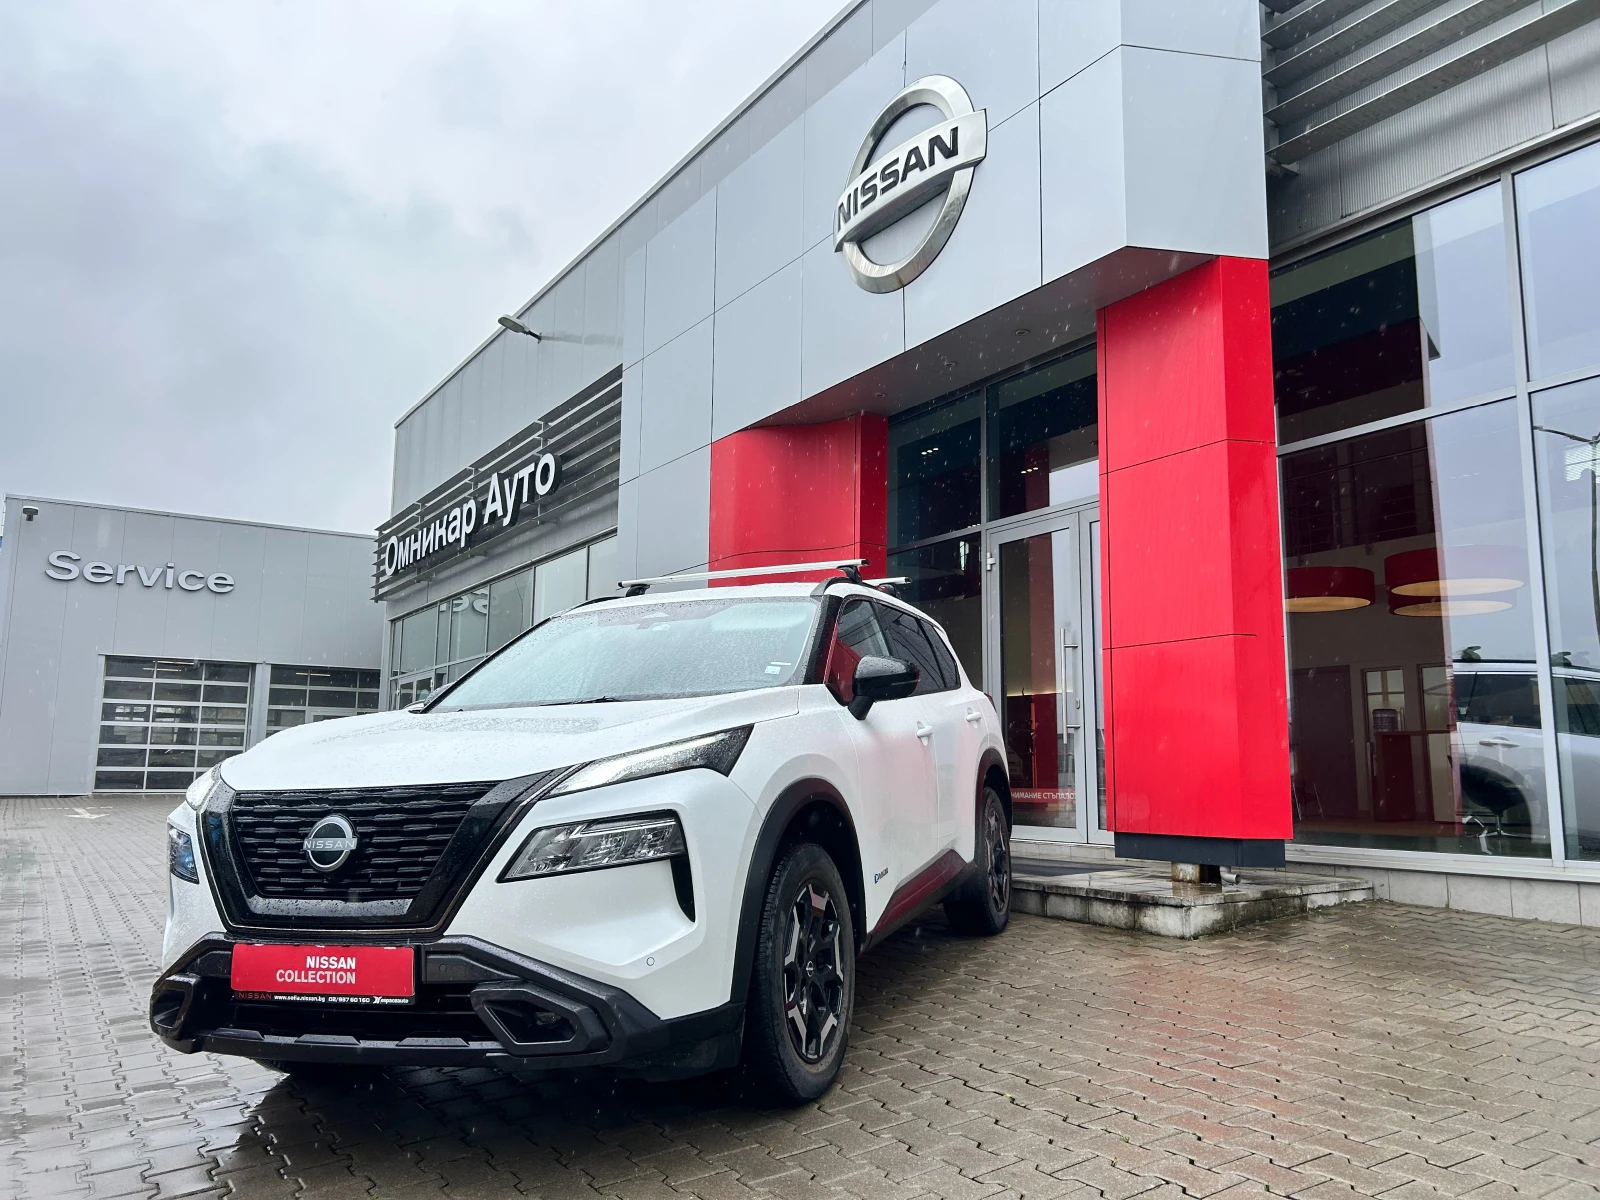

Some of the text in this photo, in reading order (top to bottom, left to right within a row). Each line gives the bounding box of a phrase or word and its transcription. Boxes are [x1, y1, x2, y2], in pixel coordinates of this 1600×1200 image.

[837, 126, 959, 233] NISSAN
[385, 453, 556, 576] Омникар Ауто
[45, 550, 235, 593] Service
[1011, 791, 1042, 799] НИМАНИЕ
[304, 840, 355, 849] NISSAN
[306, 955, 356, 970] NISSAN
[276, 969, 356, 984] COLLECTION
[238, 992, 272, 1000] NISSAN
[274, 995, 326, 1003] www.sofia.nissan.bg
